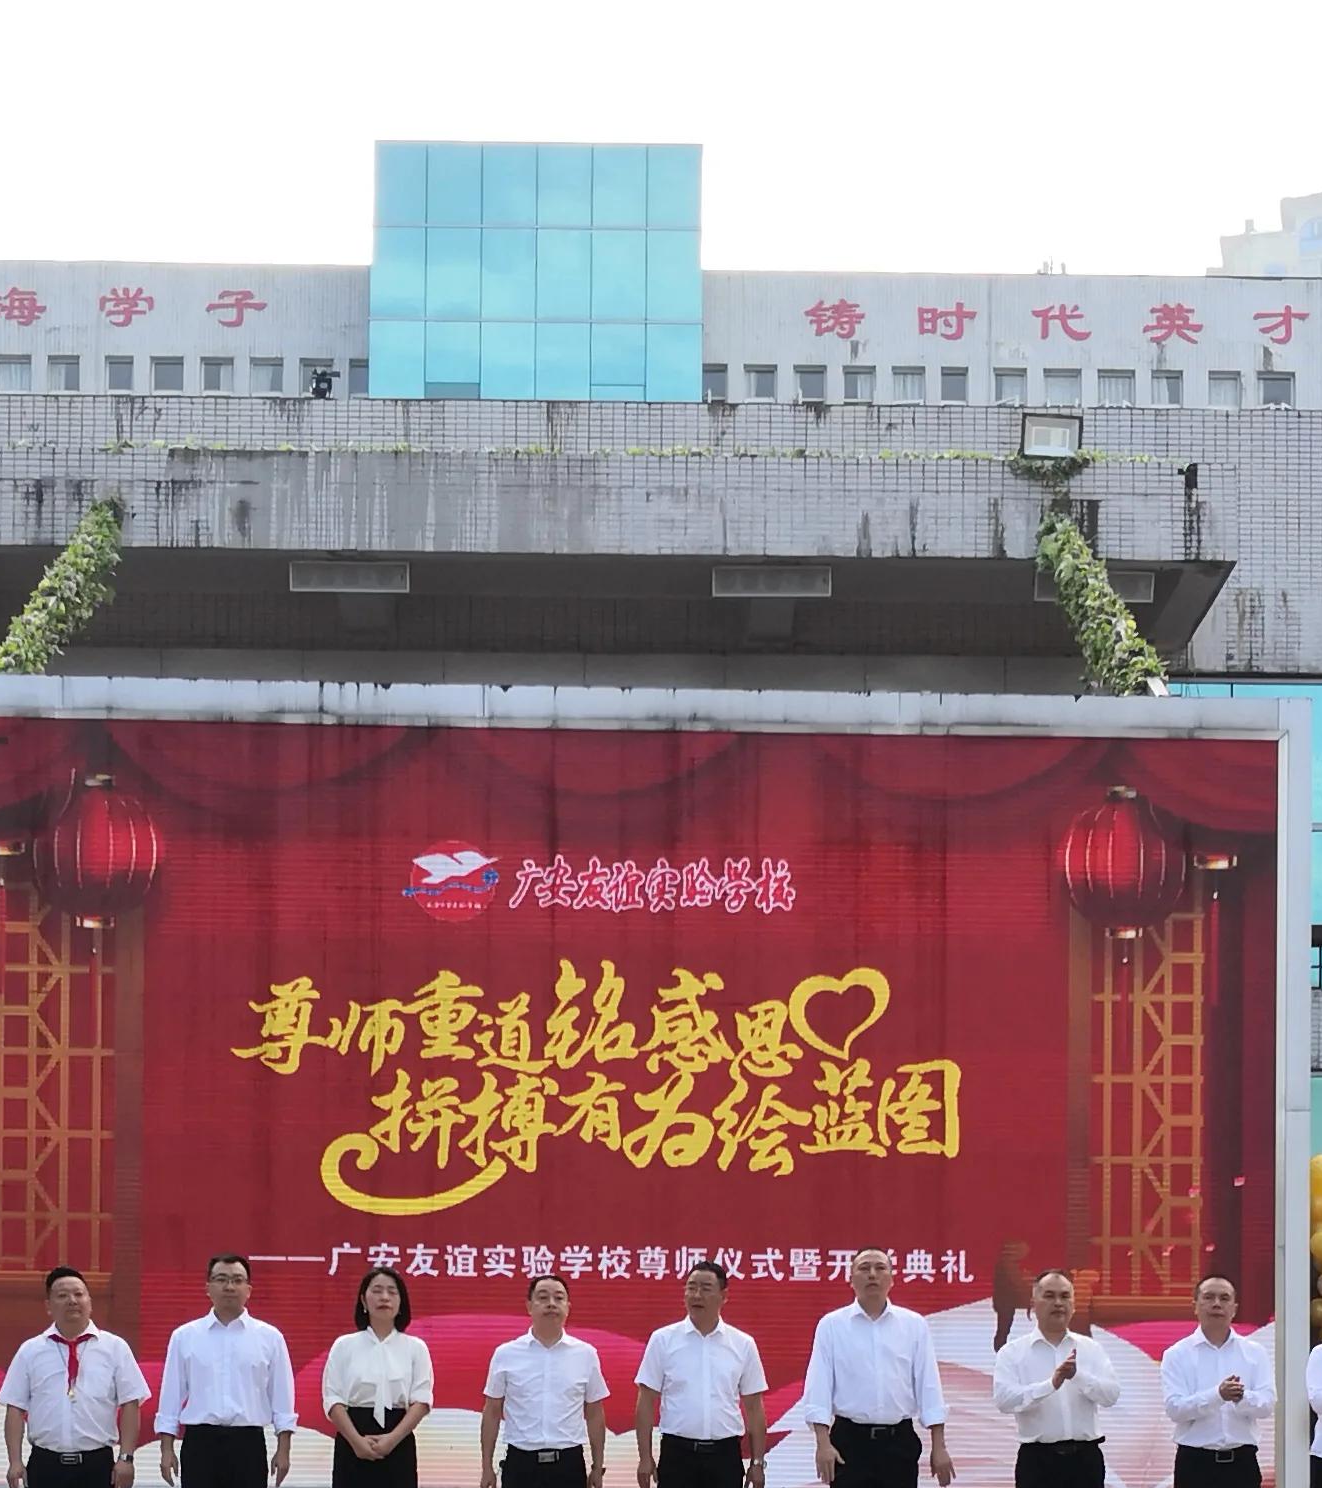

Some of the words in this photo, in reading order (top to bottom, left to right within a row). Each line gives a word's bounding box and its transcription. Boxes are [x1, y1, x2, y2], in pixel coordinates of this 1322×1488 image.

[804, 299, 1309, 344] 铸时代英才
[509, 855, 796, 913] 广安友谊实验学校
[231, 959, 803, 1077] 尊师重道铭感恩
[369, 1059, 961, 1176] 拼搏有为绘蓝图
